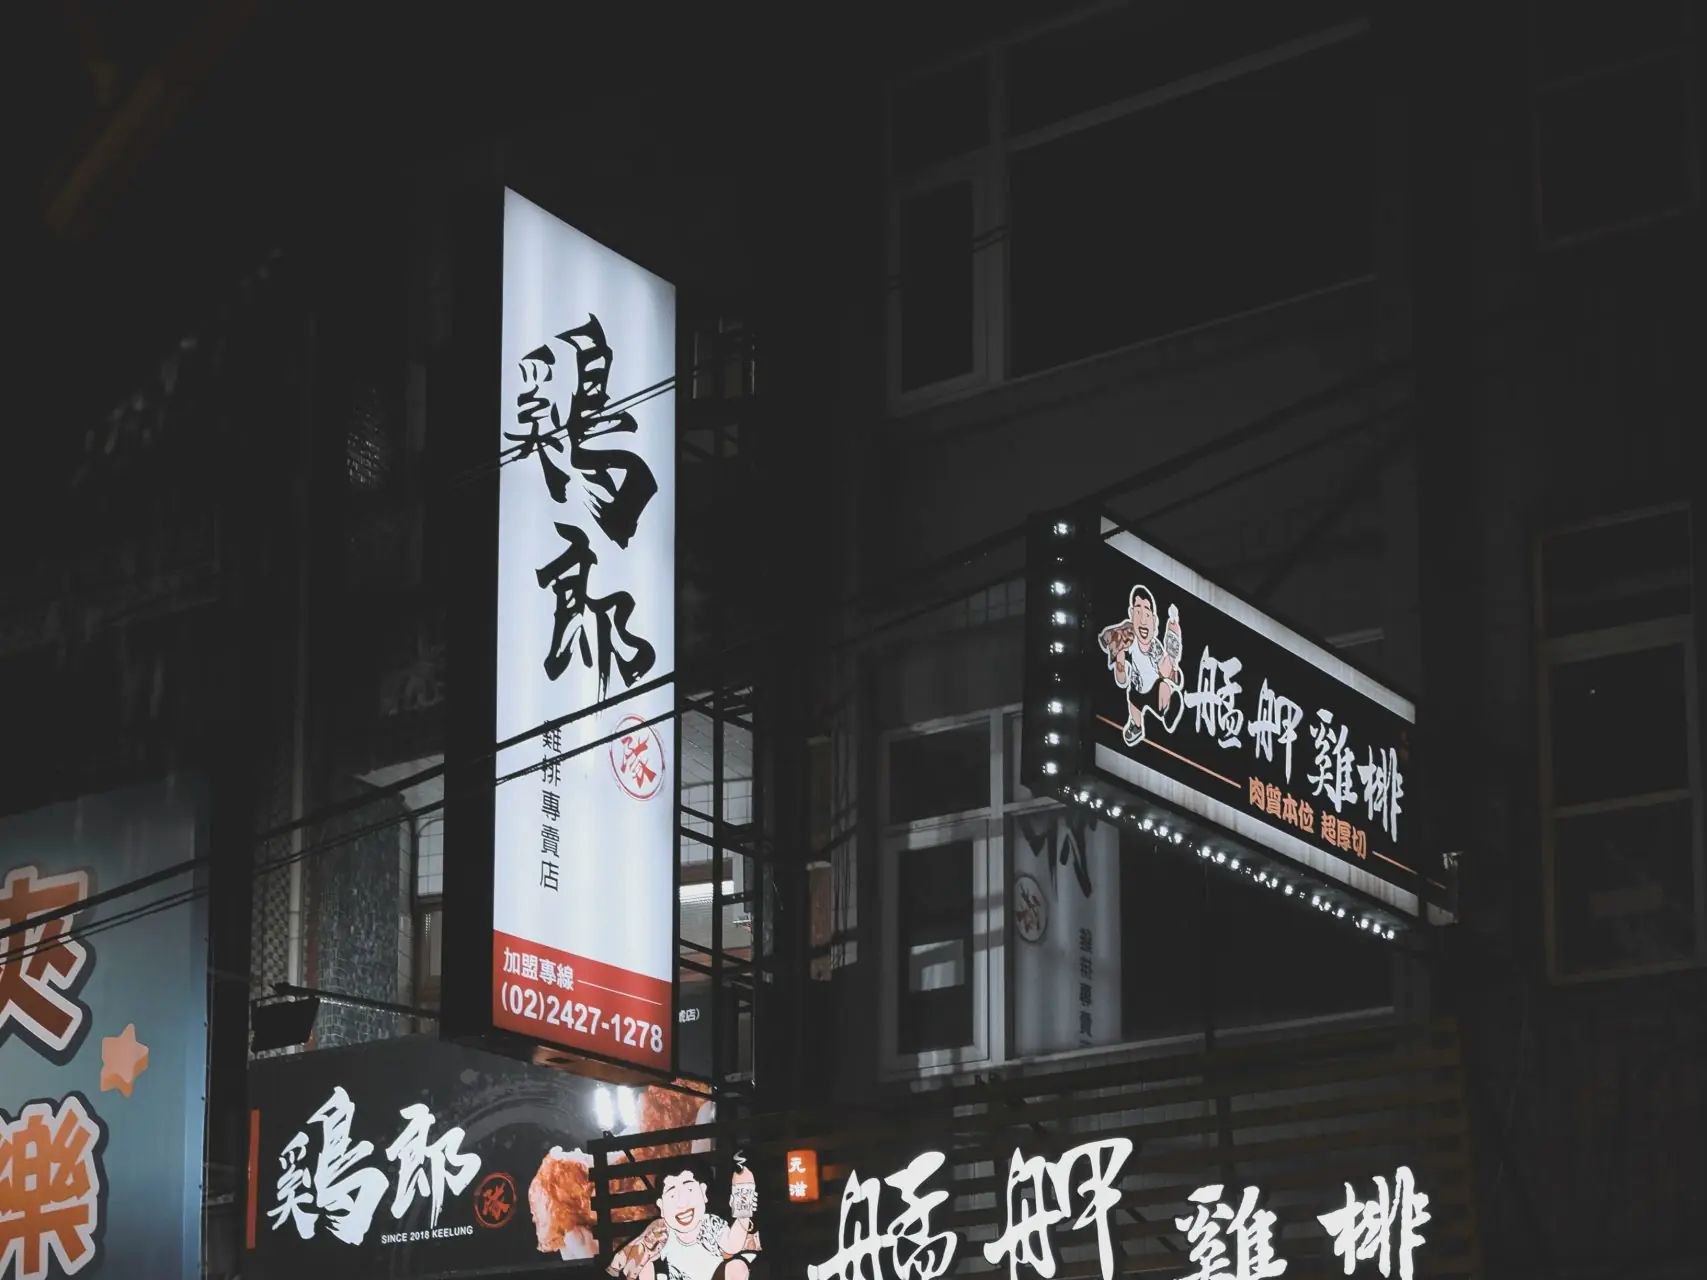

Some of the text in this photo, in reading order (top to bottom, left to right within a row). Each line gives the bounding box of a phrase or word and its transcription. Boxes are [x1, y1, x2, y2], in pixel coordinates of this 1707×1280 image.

[1184, 646, 1405, 842] 艋舺雞排
[1249, 776, 1367, 860] 肉質本位 超厚切
[503, 947, 574, 991] 加盟專線
[501, 981, 663, 1053] (02)2427-1278
[381, 1225, 474, 1244] SINCE 2018 KEELUNG
